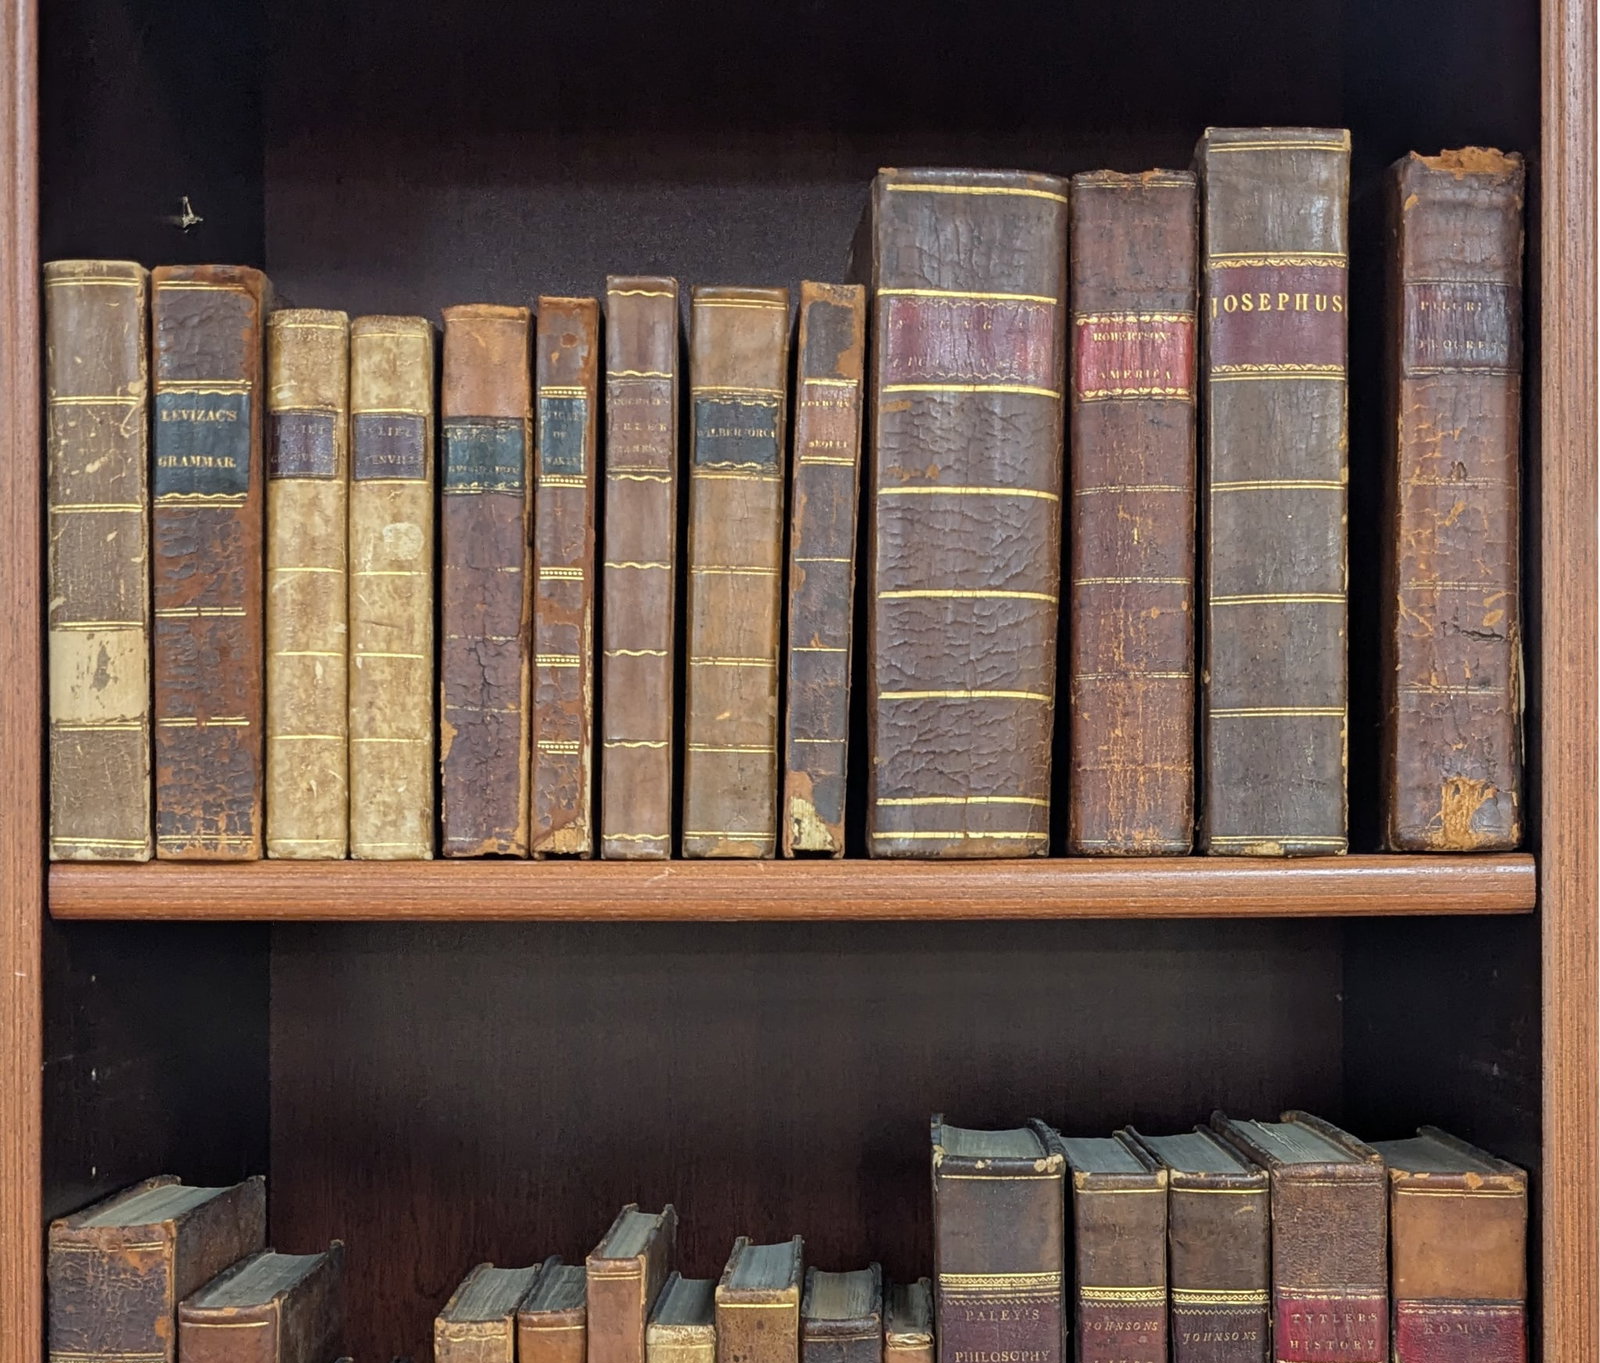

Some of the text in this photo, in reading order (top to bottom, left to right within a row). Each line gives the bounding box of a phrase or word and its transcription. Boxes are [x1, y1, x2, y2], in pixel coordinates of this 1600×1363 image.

[1211, 293, 1343, 319] JOSEPHUS
[1100, 368, 1171, 380] AMERICA
[160, 409, 238, 422] LEVIZAC'S
[965, 1308, 1040, 1321] PALEY'S
[1423, 1323, 1500, 1335] ROMAN
[1290, 1340, 1375, 1351] HISTORY
[955, 1350, 1050, 1363] PHILOSOPHY
